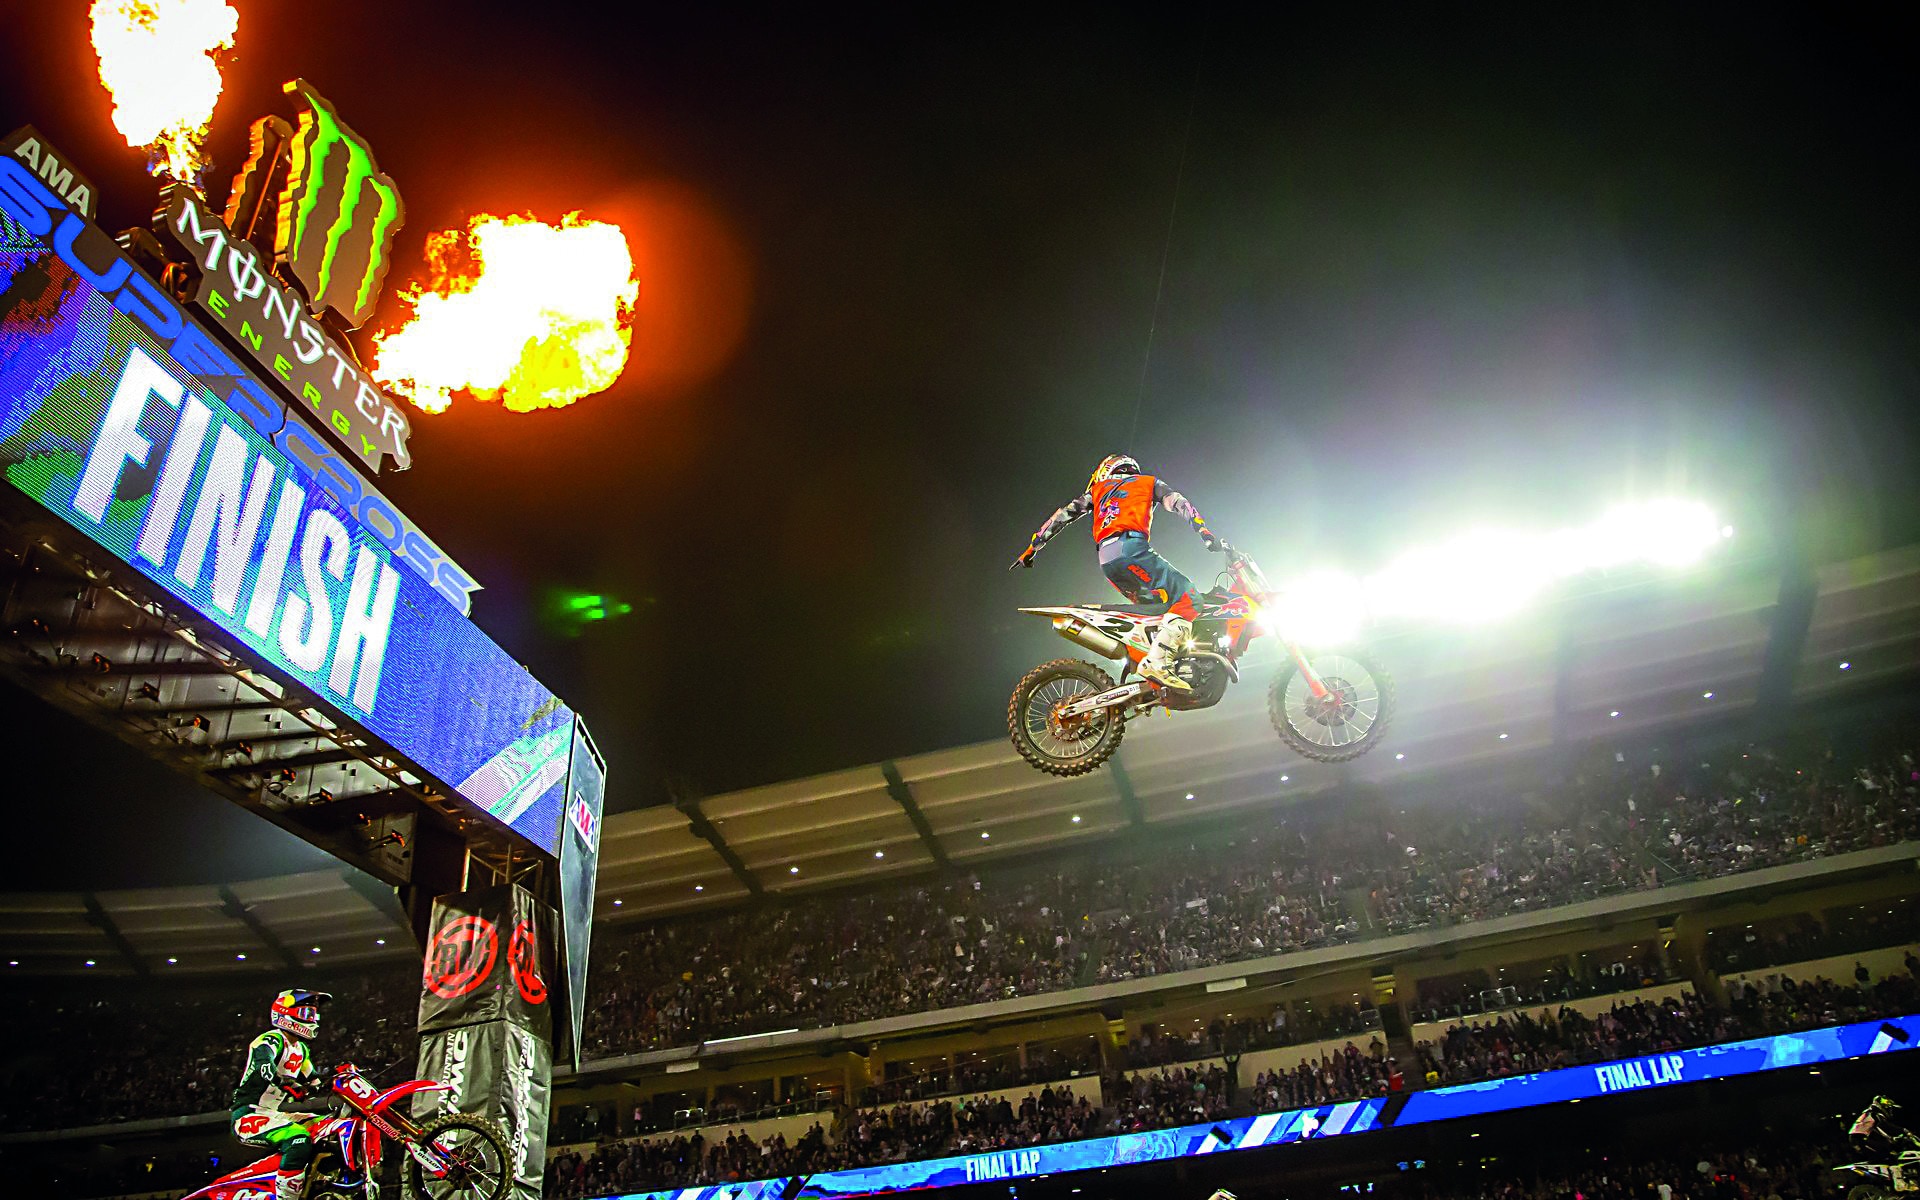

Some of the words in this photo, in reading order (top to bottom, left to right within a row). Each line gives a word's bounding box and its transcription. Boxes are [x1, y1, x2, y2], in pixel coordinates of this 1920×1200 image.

[14, 137, 90, 218] AMA
[0, 156, 473, 617] SUPERCROSS
[207, 289, 377, 457] ENERGY
[73, 346, 401, 715] FINISH
[571, 796, 595, 845] AMA
[279, 1017, 293, 1029] Red
[293, 1022, 310, 1036] Bull
[1594, 1061, 1652, 1093] FINAL
[1648, 1055, 1684, 1084] LAP
[417, 1151, 442, 1169] DUNLOP
[965, 1153, 1010, 1182] FINAL
[1011, 1150, 1041, 1177] LAP
